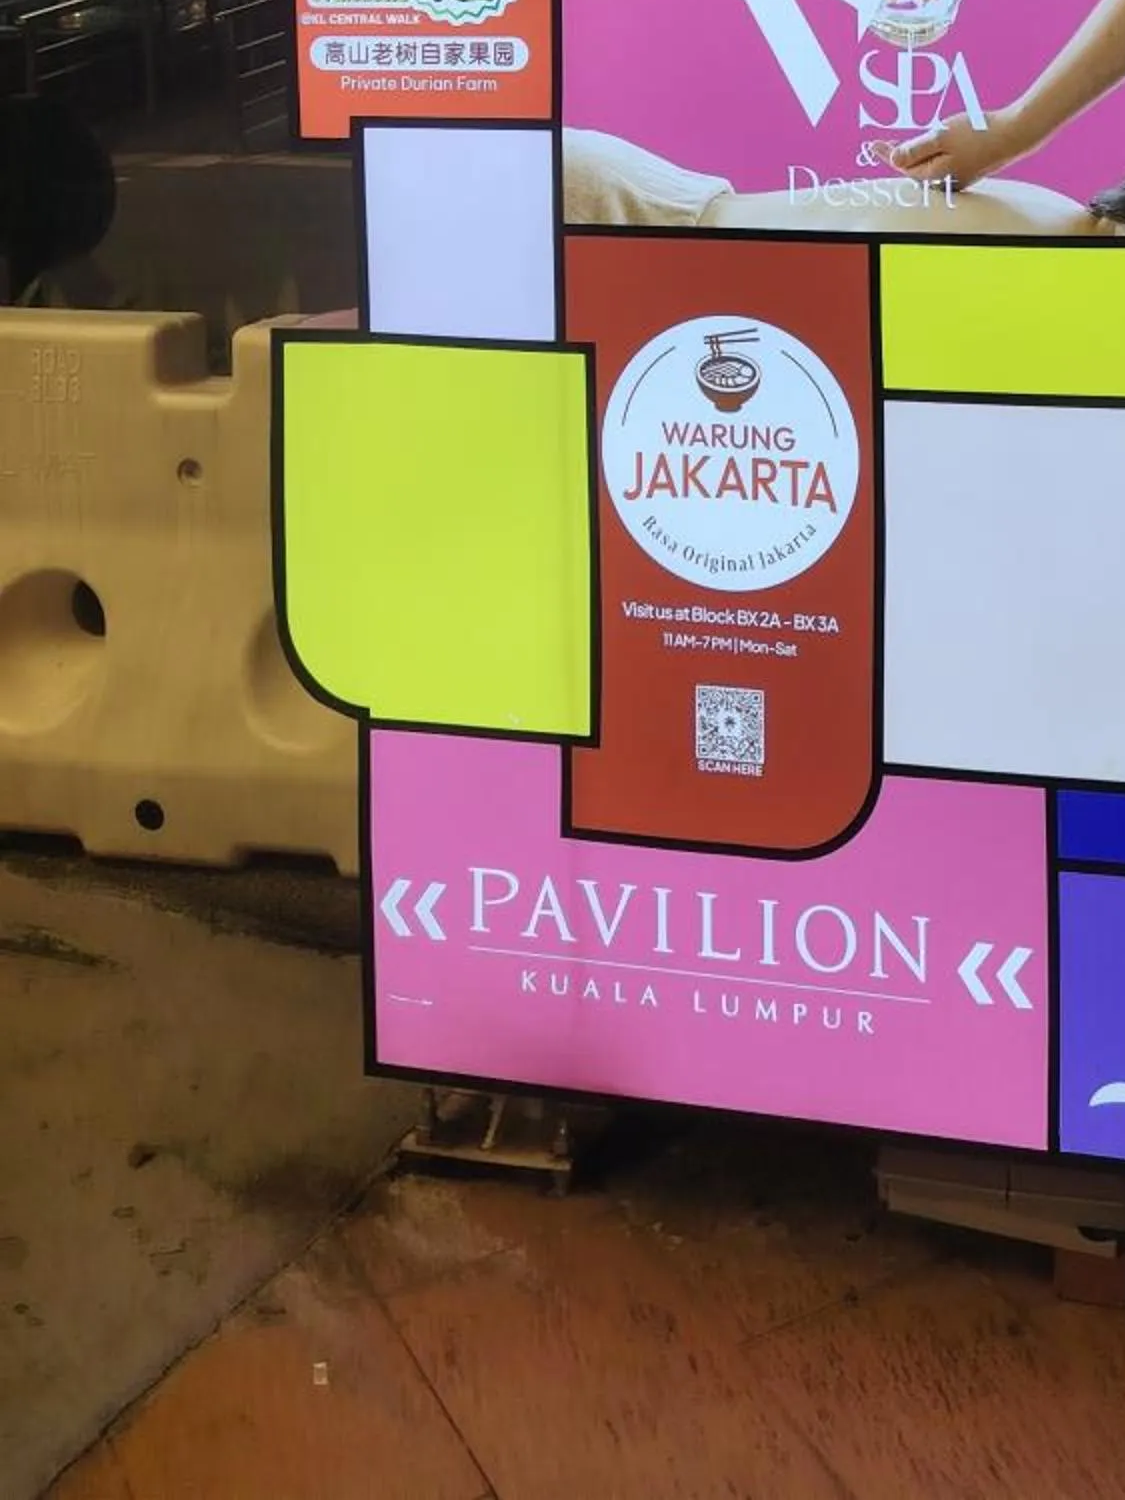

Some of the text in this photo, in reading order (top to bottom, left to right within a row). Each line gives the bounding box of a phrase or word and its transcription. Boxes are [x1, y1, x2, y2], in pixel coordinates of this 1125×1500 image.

[328, 13, 383, 26] CENTRAL
[385, 13, 421, 26] WALK
[325, 40, 516, 67] 高山老树自家果园
[341, 75, 498, 92] Private Durian Farm
[858, 46, 990, 131] SPA
[856, 141, 881, 167] &
[787, 164, 958, 210] Dessert
[661, 420, 797, 452] WARUNG
[623, 451, 839, 515] JAKARTA
[641, 515, 818, 574] Rasa Original Jakarta
[621, 601, 654, 619] Visit
[656, 606, 673, 620] us
[675, 607, 691, 621] at
[691, 605, 736, 626] Block
[697, 759, 763, 777] SCAN HERE
[468, 866, 931, 984] PAVILION
[521, 971, 876, 1035] KUALA LUMPUR
